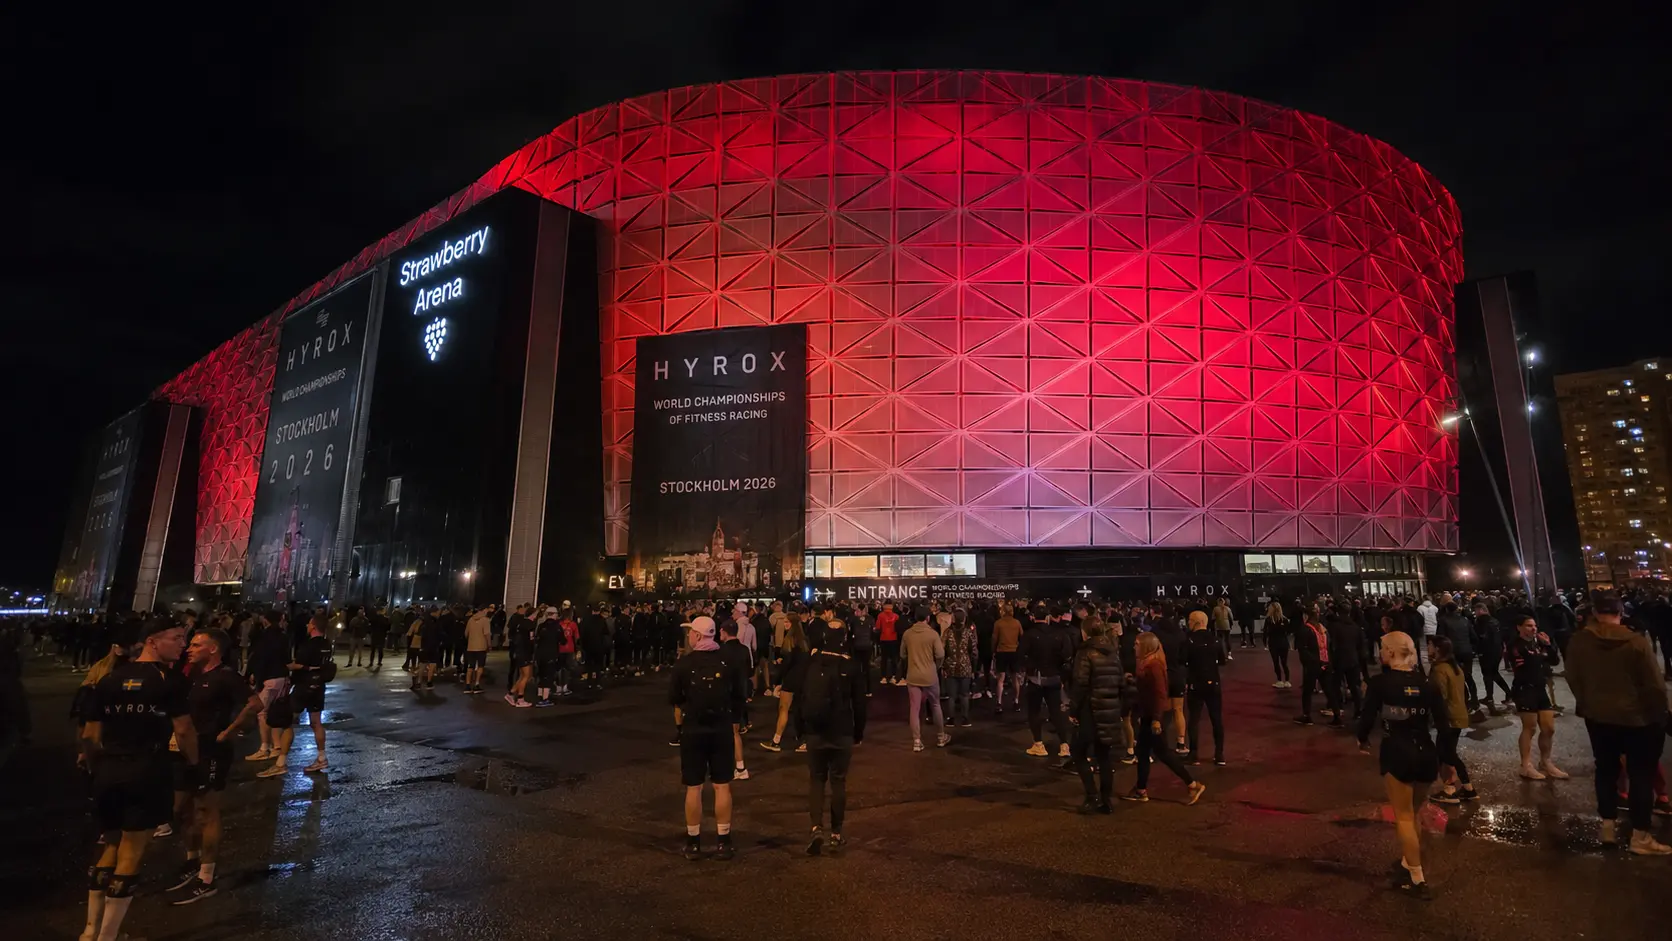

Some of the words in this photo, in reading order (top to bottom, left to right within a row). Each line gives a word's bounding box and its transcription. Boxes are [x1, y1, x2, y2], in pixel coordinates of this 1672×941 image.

[400, 225, 490, 287] Strawberry
[414, 276, 464, 315] Arena
[286, 321, 352, 372] HYROX
[653, 350, 786, 381] HYROX
[653, 398, 692, 410] WORLD
[694, 391, 786, 407] CHAMPIONSHIPS
[275, 407, 339, 445] STOCKHOLM
[669, 415, 682, 425] OF
[684, 412, 727, 424] FITNESS
[729, 409, 768, 421] RACING
[269, 443, 334, 484] 2026
[660, 479, 740, 494] STOCKHOLM
[743, 477, 776, 490] 2026
[848, 585, 927, 599] ENTRANCE
[1157, 585, 1230, 596] HYROX
[104, 703, 157, 714] HYROX
[1390, 707, 1431, 716] HYRO
